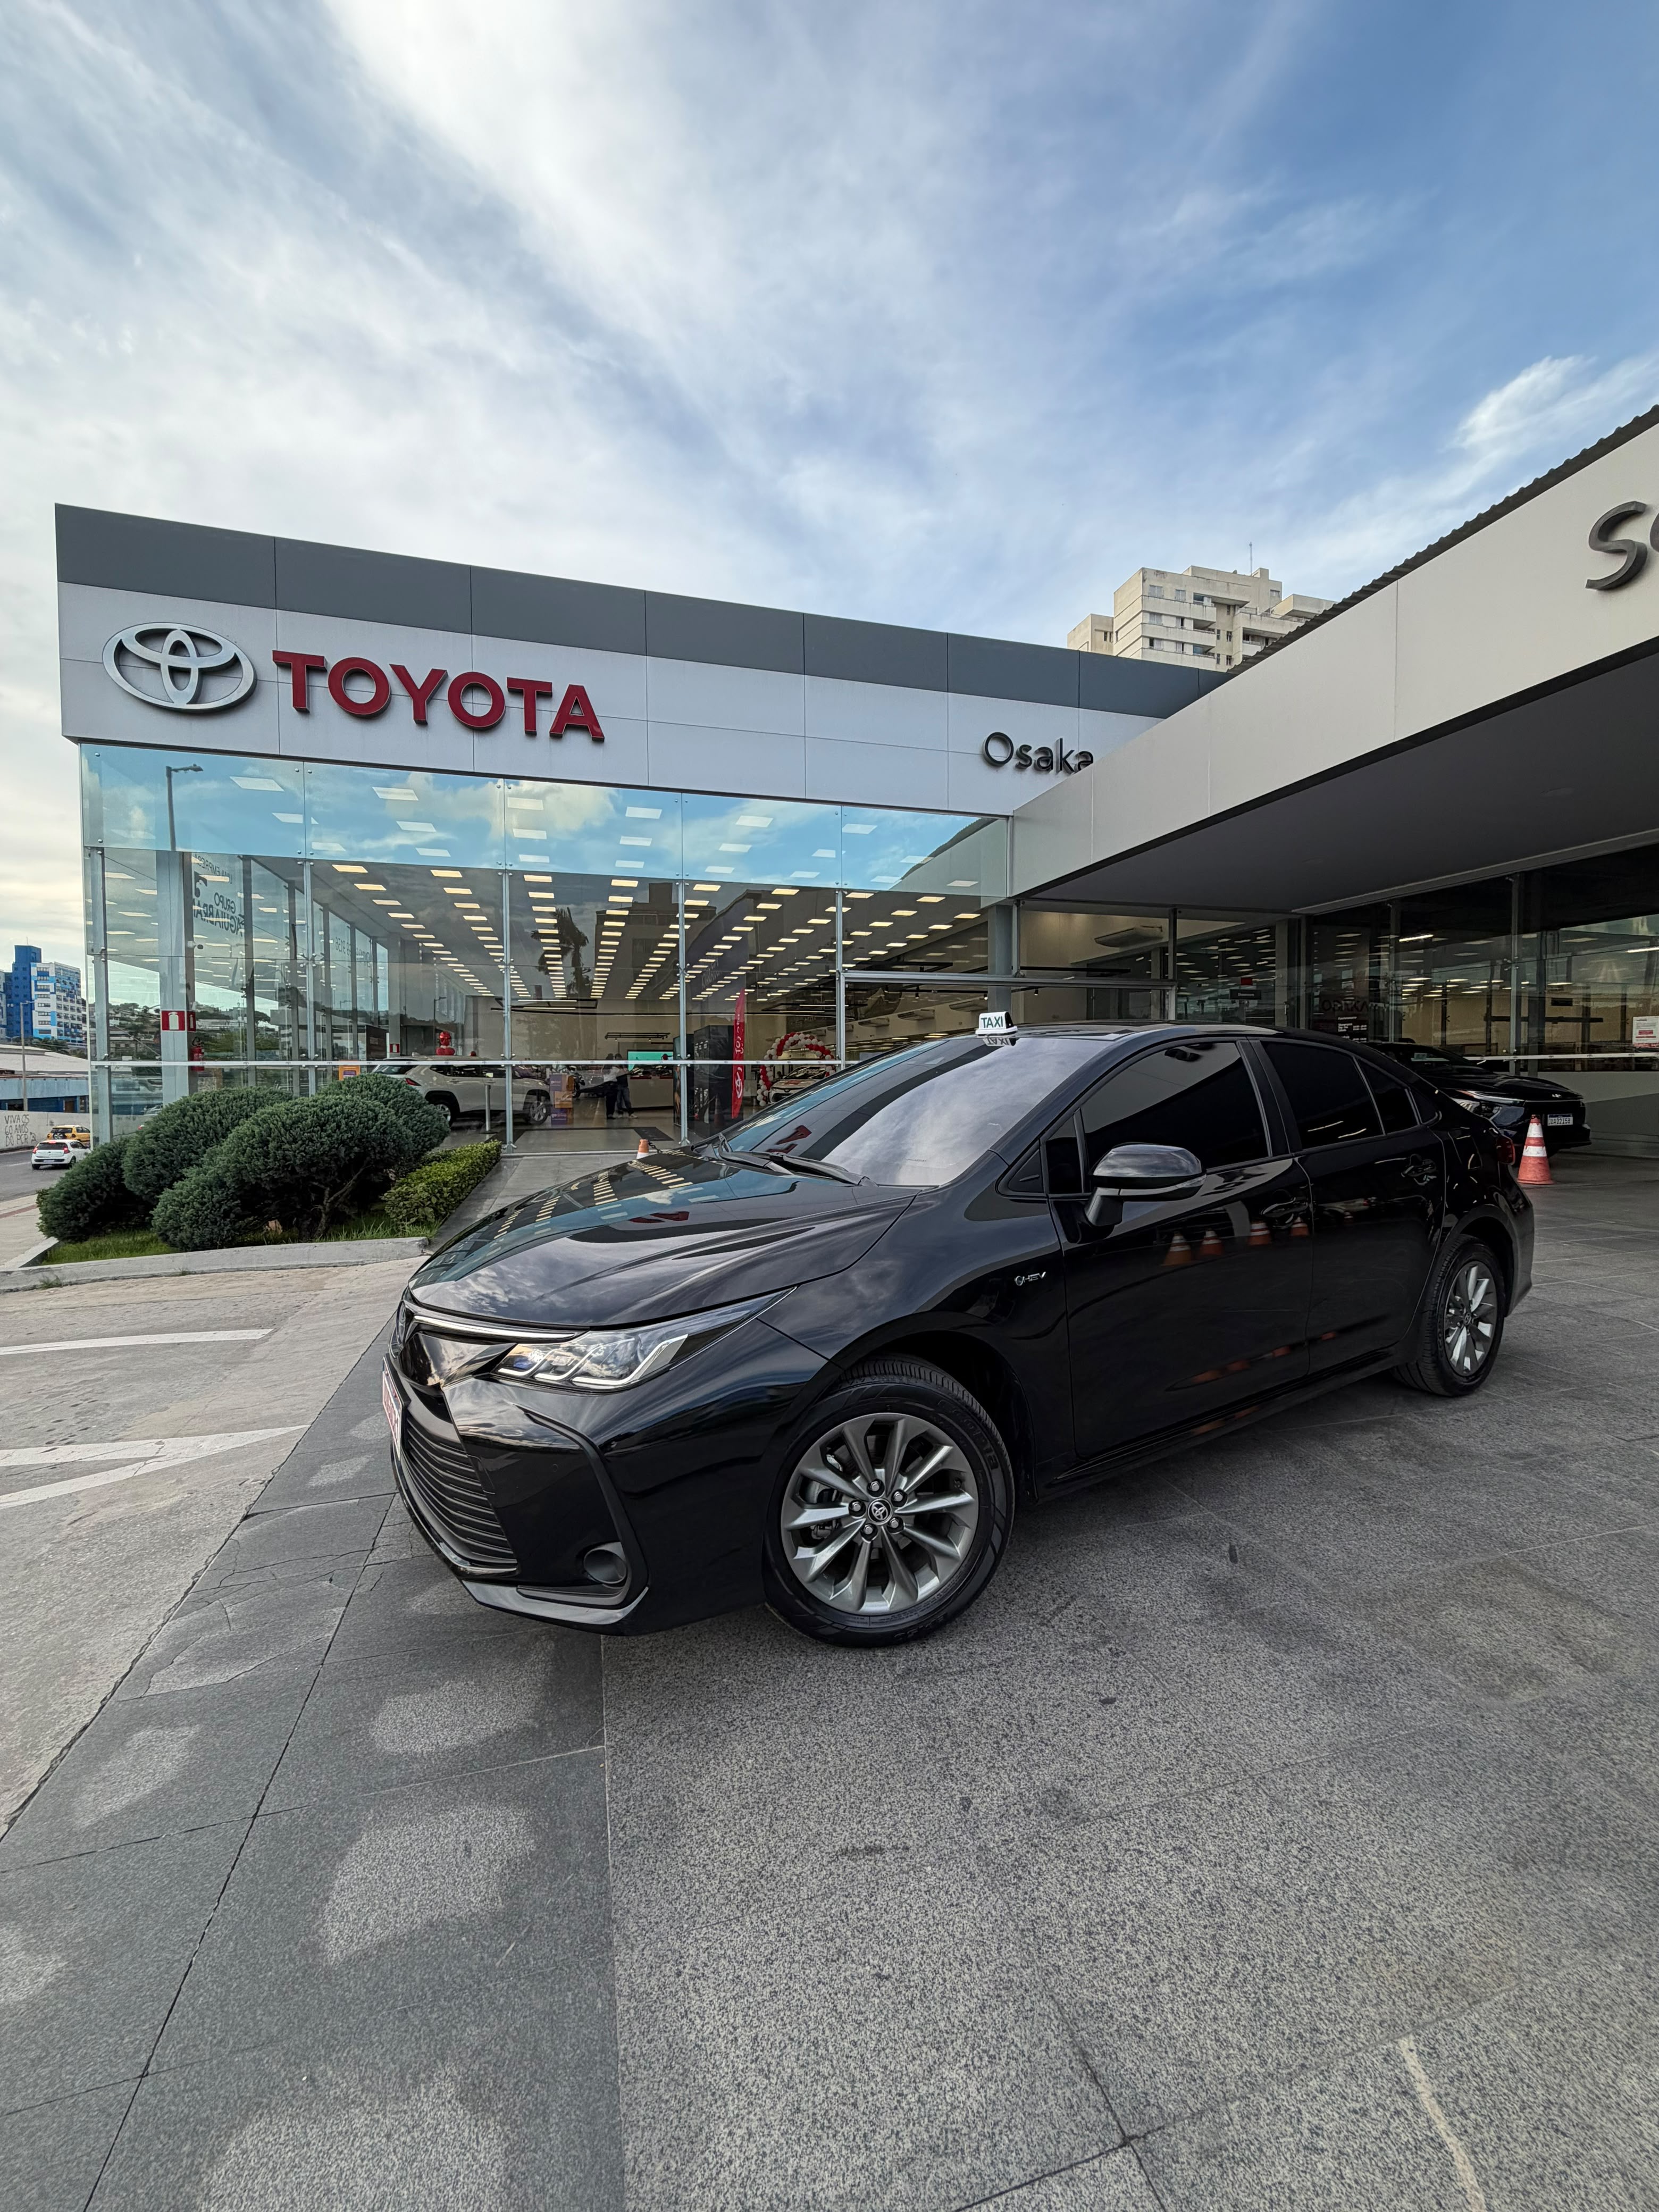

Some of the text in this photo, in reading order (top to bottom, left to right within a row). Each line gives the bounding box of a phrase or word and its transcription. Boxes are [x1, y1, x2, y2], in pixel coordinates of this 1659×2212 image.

[1585, 501, 1659, 590] S
[272, 649, 605, 742] TOYOTA
[982, 732, 1094, 773] Osaka
[981, 1016, 1003, 1028] TAXI
[5, 1115, 20, 1124] VIVA
[5, 1125, 13, 1136] 60
[5, 1135, 14, 1147] DO
